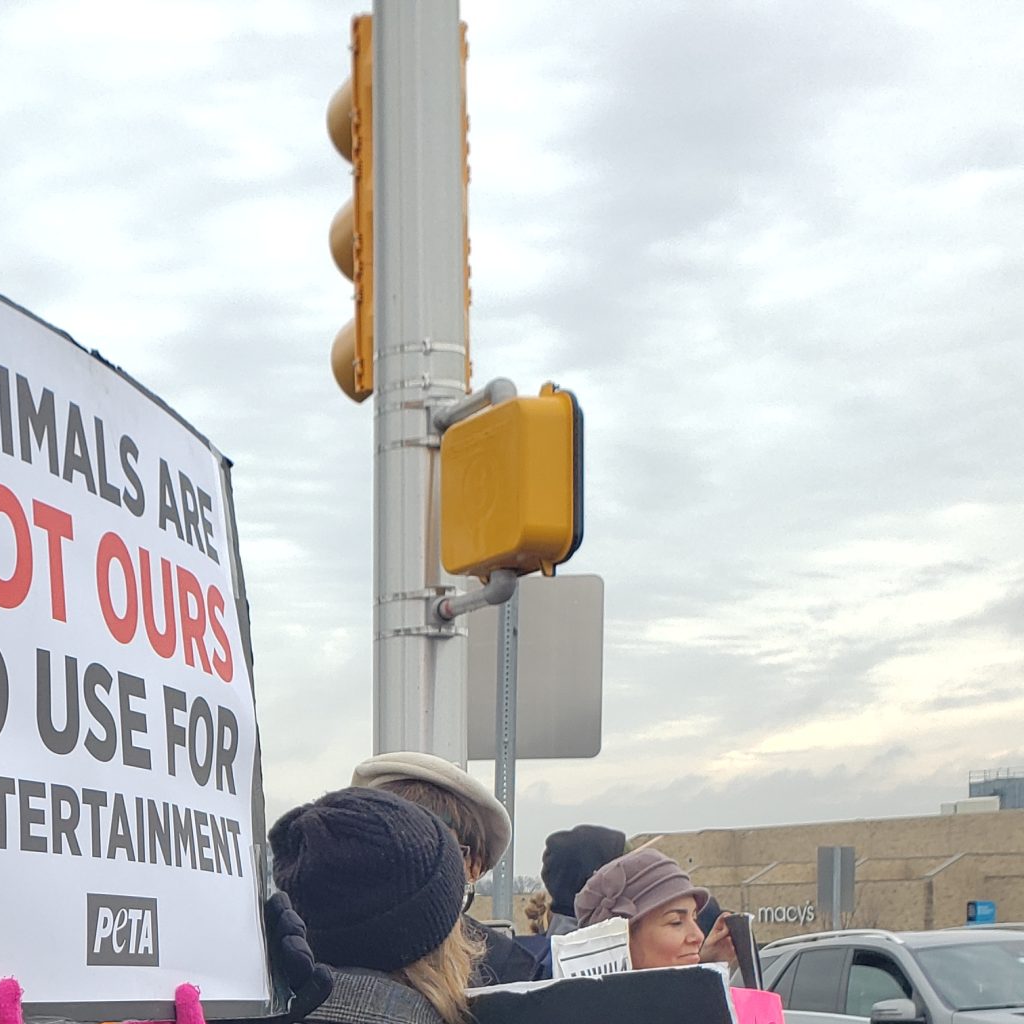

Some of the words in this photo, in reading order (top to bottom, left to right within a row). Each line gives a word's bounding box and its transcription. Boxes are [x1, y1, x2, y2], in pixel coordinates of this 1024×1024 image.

[158, 454, 220, 566] ARE
[97, 532, 234, 683] OURS
[37, 648, 152, 771] USE
[163, 685, 239, 796] FOR
[758, 900, 815, 927] macy's
